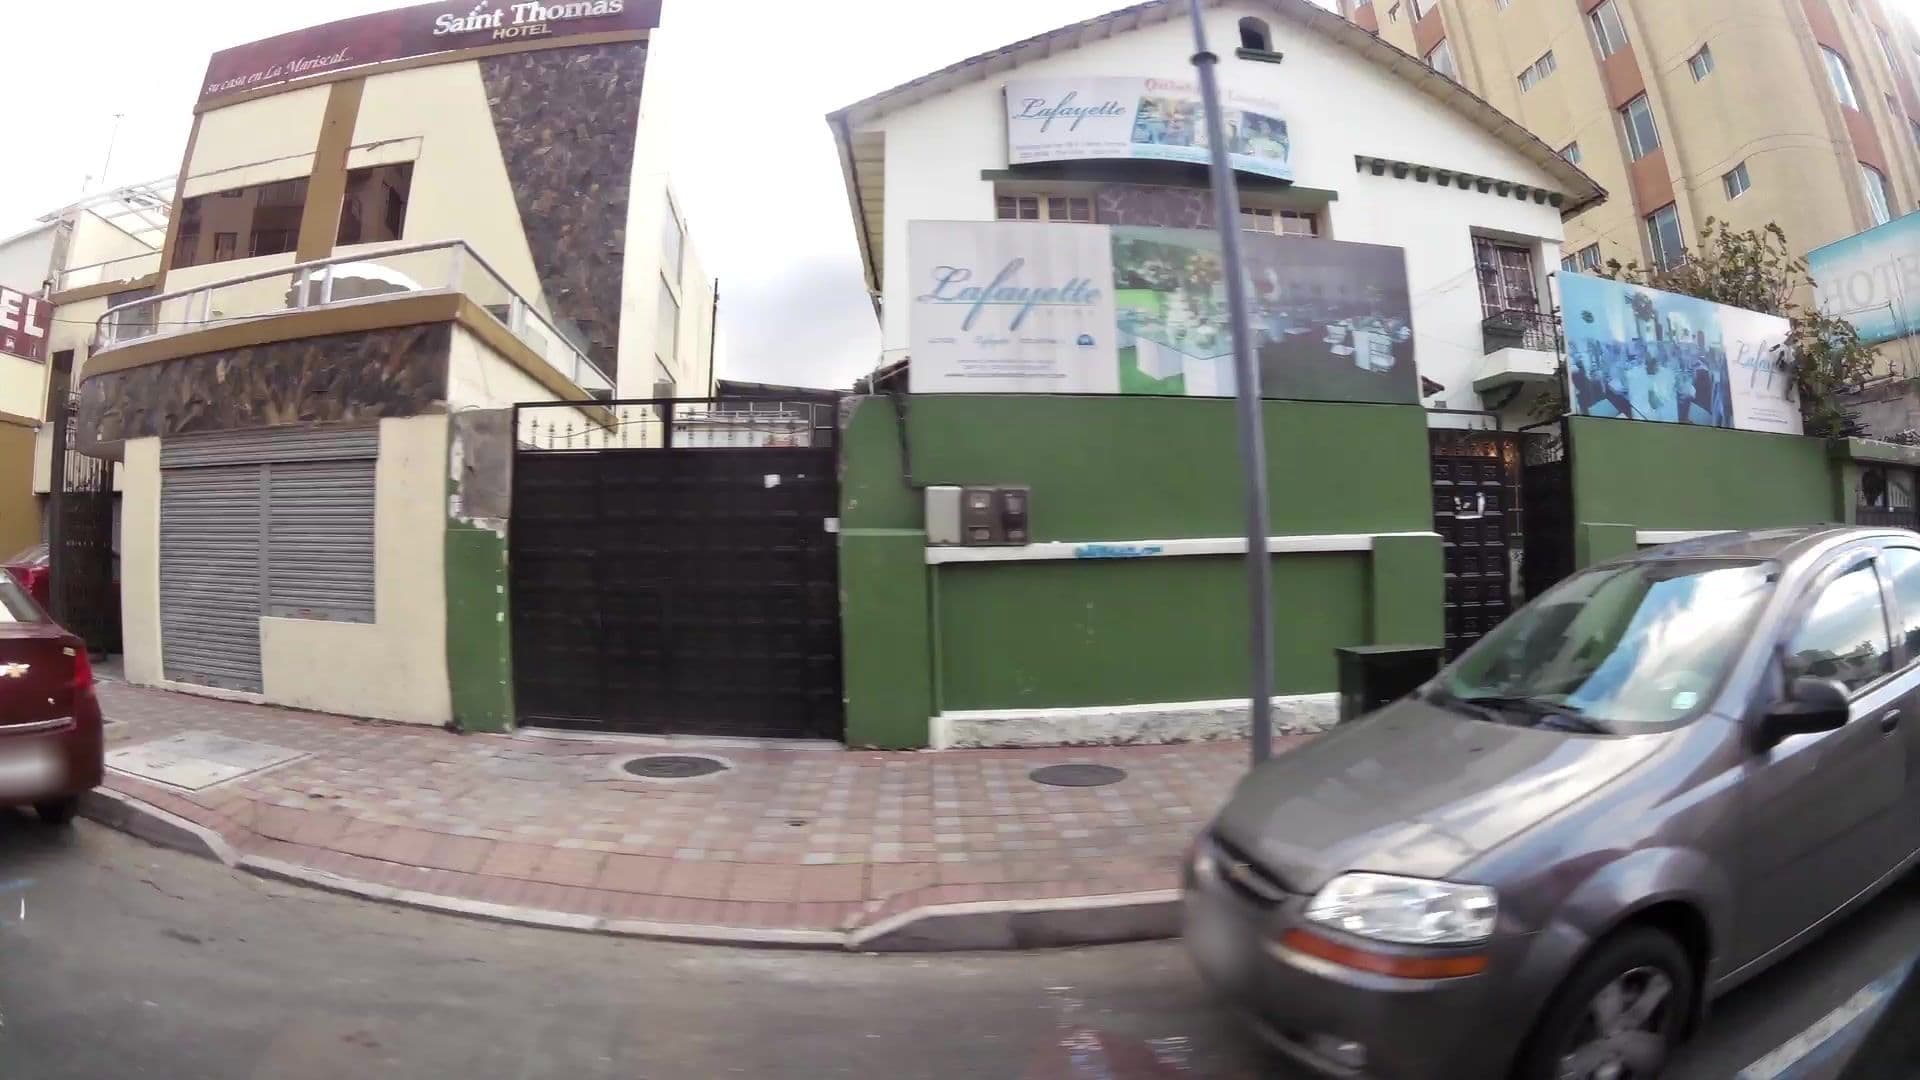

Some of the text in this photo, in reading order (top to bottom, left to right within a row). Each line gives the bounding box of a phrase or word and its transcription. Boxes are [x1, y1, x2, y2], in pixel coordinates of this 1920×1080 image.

[433, 0, 624, 35] Saint Thomas
[493, 24, 552, 40] HOTEL
[221, 75, 247, 90] casa
[248, 71, 263, 84] en
[263, 65, 282, 79] La
[1012, 91, 1126, 133] Lafayette
[916, 257, 1102, 331] Lafayette
